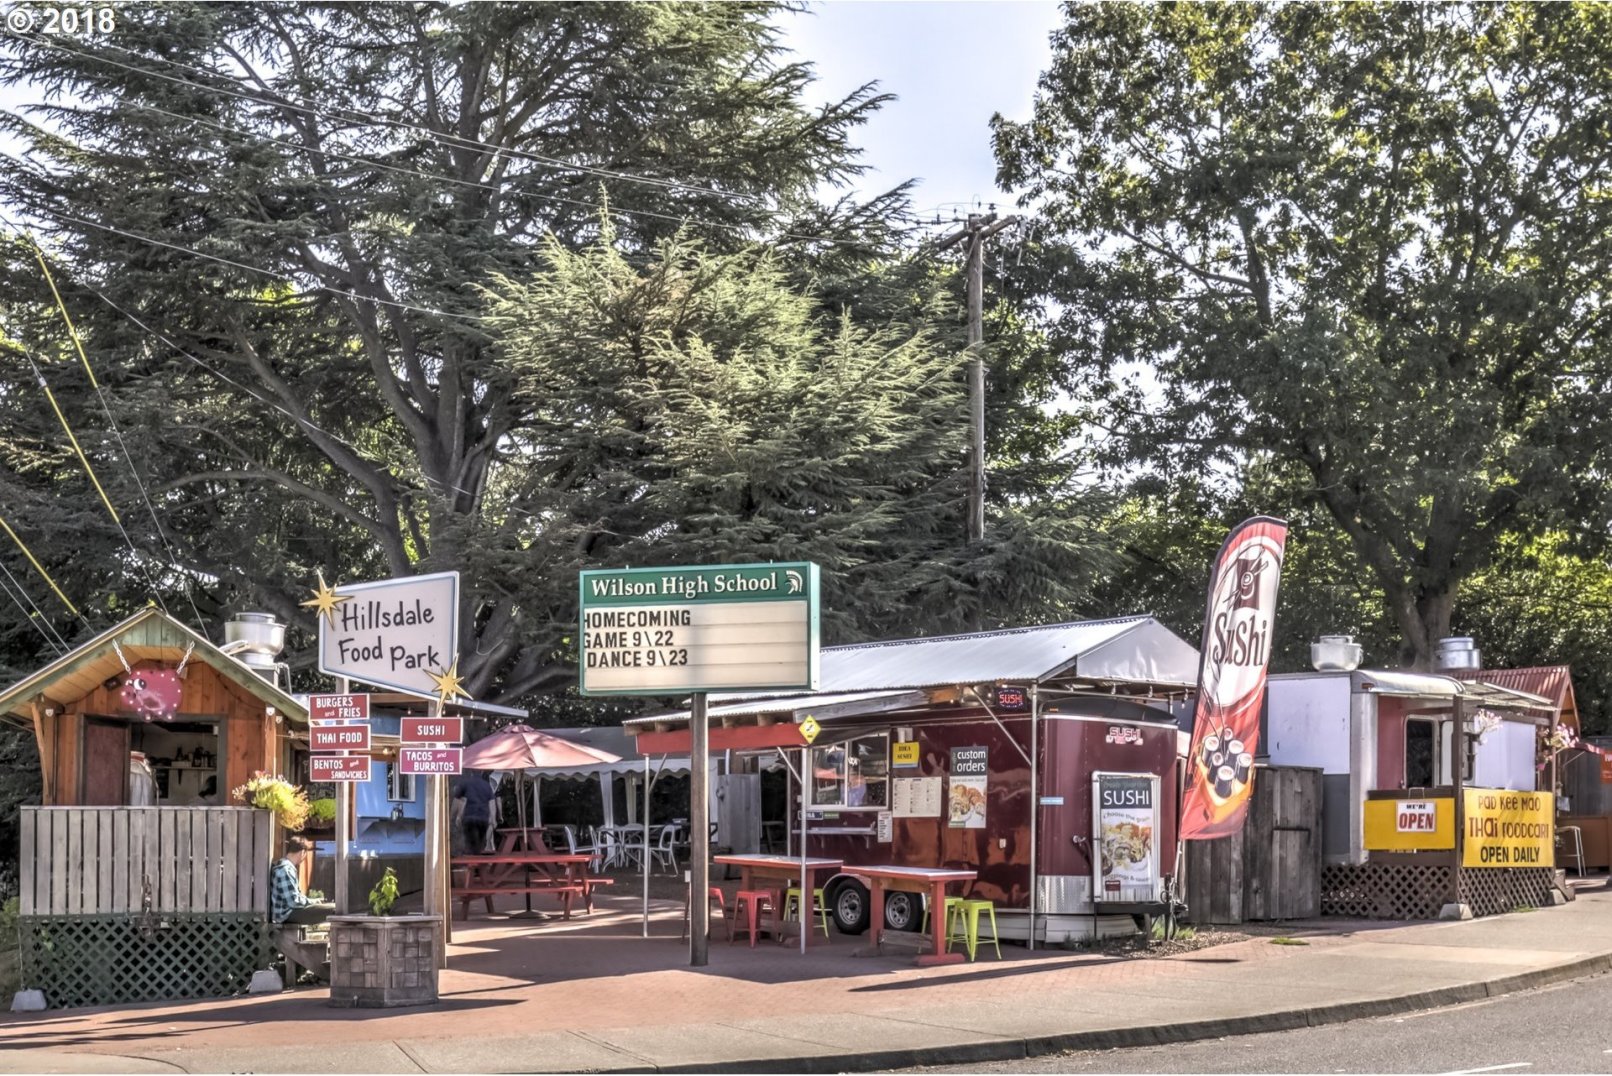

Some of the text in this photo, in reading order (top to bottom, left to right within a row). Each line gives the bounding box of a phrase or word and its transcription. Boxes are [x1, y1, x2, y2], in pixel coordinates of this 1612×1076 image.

[591, 572, 777, 599] Wilson High School
[341, 599, 435, 632] Hillsdale
[584, 610, 691, 628] HOMECOMING
[584, 631, 627, 648] GAME
[1212, 612, 1267, 667] Sushi
[338, 635, 383, 665] Food
[587, 650, 641, 668] DANCE
[316, 697, 354, 708] BURGERS
[999, 694, 1024, 704] SUSHI
[338, 707, 361, 718] FRIES
[416, 725, 446, 736] SUSHI
[1109, 726, 1141, 739] SUSHI
[316, 732, 362, 744] THAI FOOD
[406, 751, 433, 761] TACOS
[957, 749, 986, 760] custom
[314, 759, 359, 770] BENTOS and
[413, 761, 455, 772] BURRITOS
[956, 760, 986, 773] orders
[330, 770, 367, 780] SANDWICHES
[1103, 790, 1149, 805] SUSHI
[1399, 813, 1433, 829] OPEN
[1480, 846, 1540, 863] OPEN DAILY
